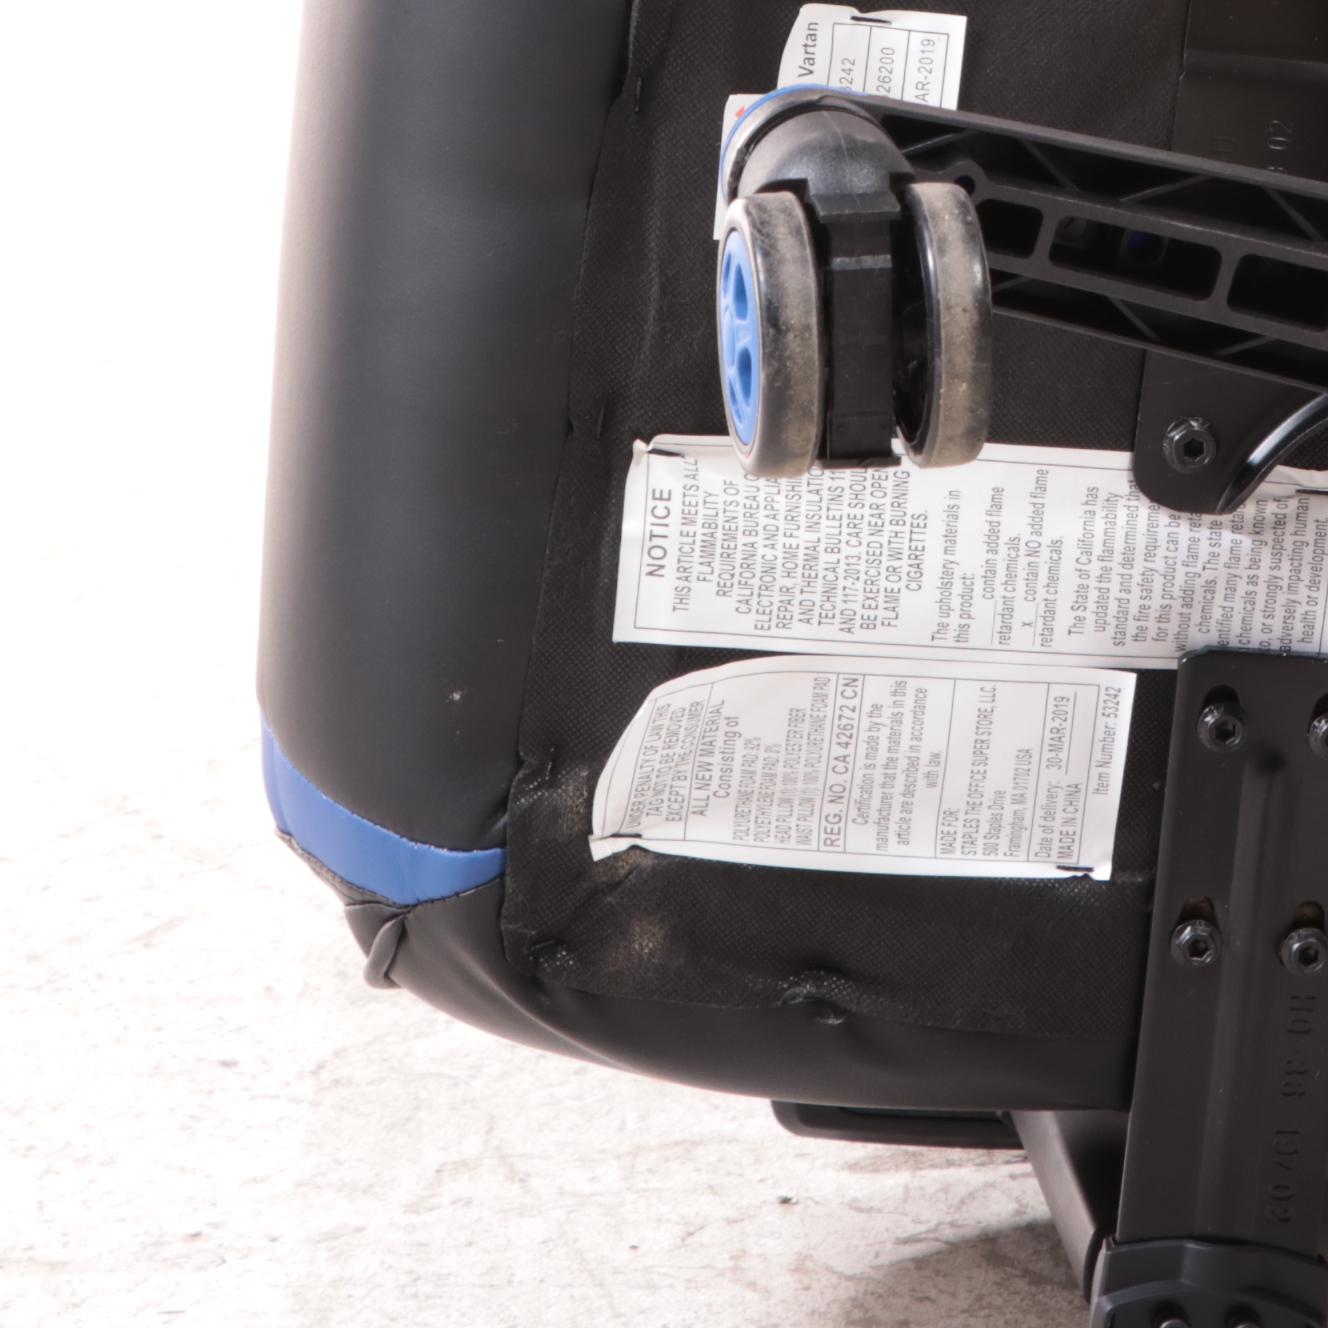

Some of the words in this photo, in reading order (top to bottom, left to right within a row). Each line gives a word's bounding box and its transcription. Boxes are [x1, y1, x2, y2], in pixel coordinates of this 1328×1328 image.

[797, 21, 818, 77] Vartan
[836, 57, 856, 92] 242
[874, 46, 895, 99] 26200
[914, 38, 935, 103] AR-2019
[682, 456, 699, 481] ALL
[743, 471, 763, 481] O
[827, 468, 846, 481] 11
[1029, 468, 1049, 499] flame
[722, 478, 740, 496] OF
[763, 474, 783, 520] APPLIA
[804, 466, 827, 532] INSULATIO
[847, 465, 869, 509] SHOUL
[888, 470, 910, 526] BURNING
[943, 489, 961, 500] in
[984, 486, 1004, 517] flame
[1080, 485, 1099, 506] has
[680, 483, 700, 526] MEETS
[741, 484, 760, 537] BUREAU
[782, 475, 802, 538] FURNISHI
[823, 485, 845, 554] BULLETINS
[867, 502, 885, 536] NEAR
[1027, 501, 1045, 537] added
[645, 488, 671, 577] NOTICE
[696, 491, 718, 582] FLAMMABILITY
[762, 523, 780, 550] AND
[845, 512, 864, 547] CARE
[942, 503, 960, 555] materials
[983, 519, 1001, 555] added
[1074, 509, 1096, 566] California
[1096, 491, 1123, 562] flammability
[675, 530, 696, 582] ARTICLE
[715, 500, 739, 597] REQUIREMENTS
[780, 542, 800, 579] HOME
[886, 529, 904, 561] WITH
[905, 511, 927, 591] CIGARETTES.
[1023, 539, 1042, 558] NO
[1306, 517, 1328, 591] development.
[735, 541, 757, 614] CALIFORNIA
[799, 537, 821, 595] THERMAL
[841, 552, 861, 604] 117-2013.
[861, 540, 883, 610] EXERCISED
[884, 564, 902, 583] OR
[1000, 533, 1021, 592] chemicals.
[1073, 567, 1091, 580] of
[1095, 564, 1113, 584] the
[671, 585, 691, 612] THIS
[753, 554, 777, 631] ELECTRONIC
[817, 558, 840, 626] TECHNICAL
[935, 558, 959, 618] upholstery
[957, 572, 977, 620] product:
[1069, 582, 1090, 612] State
[1305, 593, 1318, 607] or
[775, 583, 797, 629] REPAIR,
[797, 598, 816, 625] AND
[838, 607, 857, 634] AND
[859, 613, 878, 630] BE
[880, 586, 901, 627] FLAME
[997, 595, 1014, 645] retardant
[1092, 586, 1111, 632] updated
[930, 621, 950, 642] The
[952, 622, 970, 643] this
[1066, 614, 1086, 636] The
[1296, 609, 1316, 644] health
[839, 676, 859, 700] CN
[887, 698, 905, 709] in
[889, 679, 907, 697] this
[979, 684, 997, 703] LLC.
[1100, 685, 1121, 718] 53242
[723, 715, 739, 728] of
[863, 719, 886, 732] by
[865, 702, 883, 718] the
[909, 687, 927, 742] accordance
[974, 705, 996, 736] STORE,
[698, 700, 725, 757] MATERIAL
[835, 704, 856, 749] 42672
[886, 711, 904, 754] materials
[1045, 695, 1069, 769] 30-MAR-2019
[863, 734, 880, 761] made
[903, 743, 921, 753] in
[970, 737, 990, 767] SUPER
[1015, 748, 1033, 766] USA
[1094, 722, 1116, 768] Number:
[694, 760, 713, 791] NEW
[712, 730, 742, 798] Consisting
[830, 753, 850, 775] CA
[858, 762, 877, 770] is
[881, 755, 899, 770] the
[899, 755, 920, 799] described
[1011, 766, 1031, 790] 01702
[827, 780, 847, 804] NO.
[878, 771, 897, 789] that
[966, 768, 987, 799] OFFICE
[1091, 771, 1110, 795] Item
[690, 794, 710, 816] ALL
[851, 772, 874, 825] Certification
[899, 799, 914, 815] are
[964, 799, 983, 816] THE
[986, 789, 1006, 811] Drive
[1009, 791, 1027, 805] MA
[1039, 782, 1064, 822] delivery:
[1061, 782, 1081, 814] CHINA
[822, 809, 843, 847] REG.
[873, 791, 893, 850] manufacturer
[894, 816, 912, 845] article
[940, 807, 959, 827] FOR:
[983, 811, 1005, 840] Staples
[1003, 807, 1028, 857] Framingham,
[1037, 823, 1055, 835] of
[1060, 816, 1077, 827] IN
[939, 829, 957, 854] MADE
[960, 817, 980, 855] STAPLES
[981, 841, 999, 856] 500
[1033, 836, 1053, 858] Date
[1056, 829, 1076, 859] MADE
